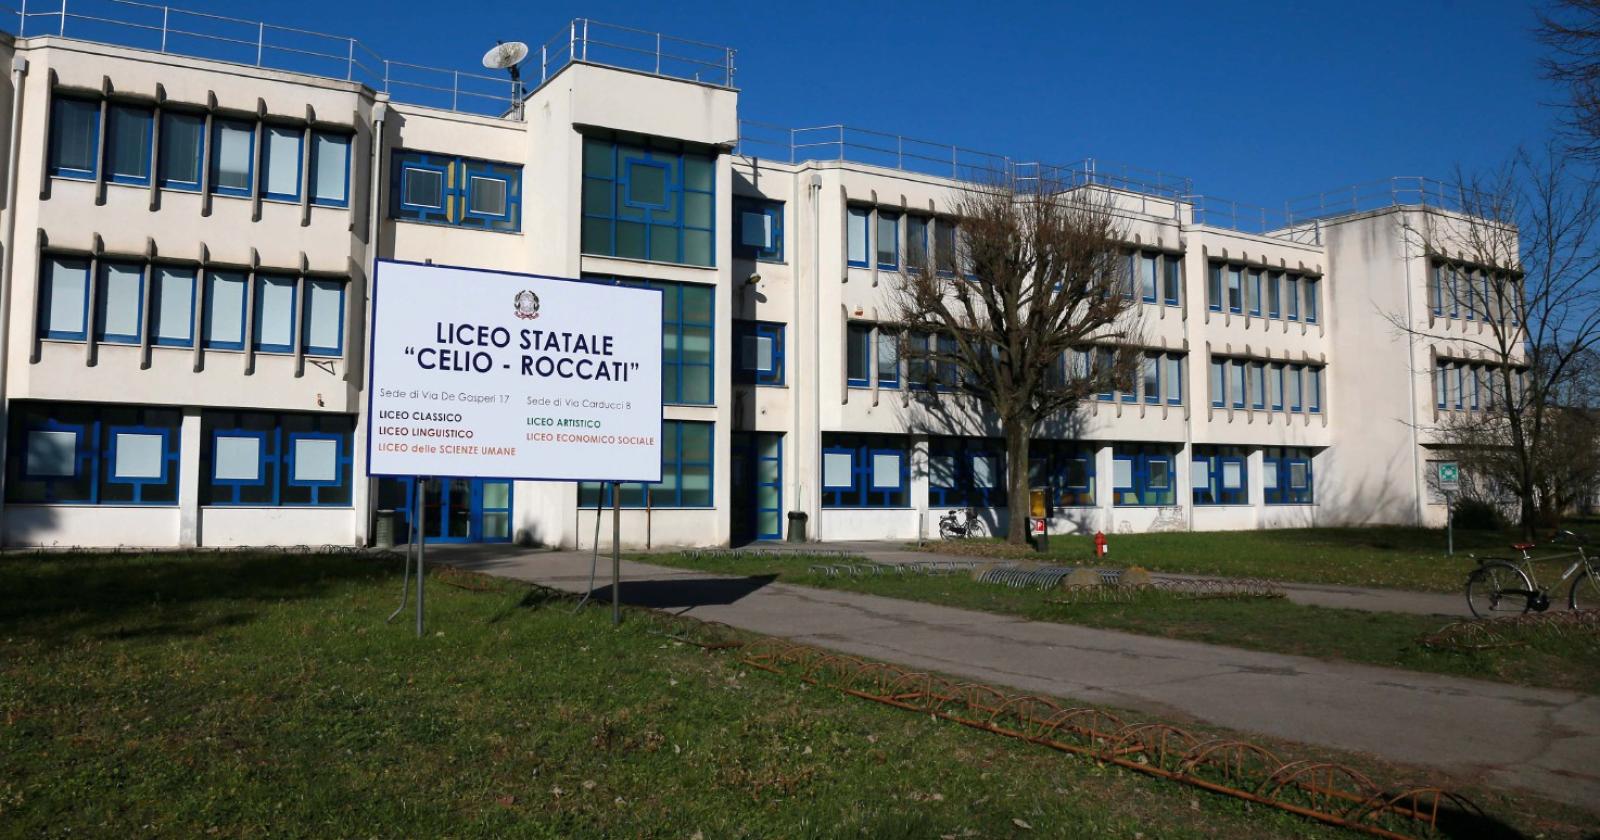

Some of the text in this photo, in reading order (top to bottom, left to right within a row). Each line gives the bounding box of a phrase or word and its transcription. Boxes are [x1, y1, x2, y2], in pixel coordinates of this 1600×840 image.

[437, 322, 613, 356] LICEO STATALE
[405, 346, 493, 374] “CELIO
[521, 355, 640, 383] ROCCATI”
[380, 388, 510, 404] Sede di Via De Gasperi 17
[527, 396, 551, 406] Sede
[553, 398, 562, 406] di
[565, 399, 580, 408] Via
[582, 399, 624, 410] Carducci
[379, 410, 462, 423] LICEO CLASSICO
[527, 417, 601, 428] LICEO ARTISTICO
[379, 426, 474, 439] LICEO LINGUISTICO
[526, 432, 655, 446] LICEO ECONOMICO SOCIALE
[378, 443, 516, 456] LICEO delle SCIENZE UMANE
